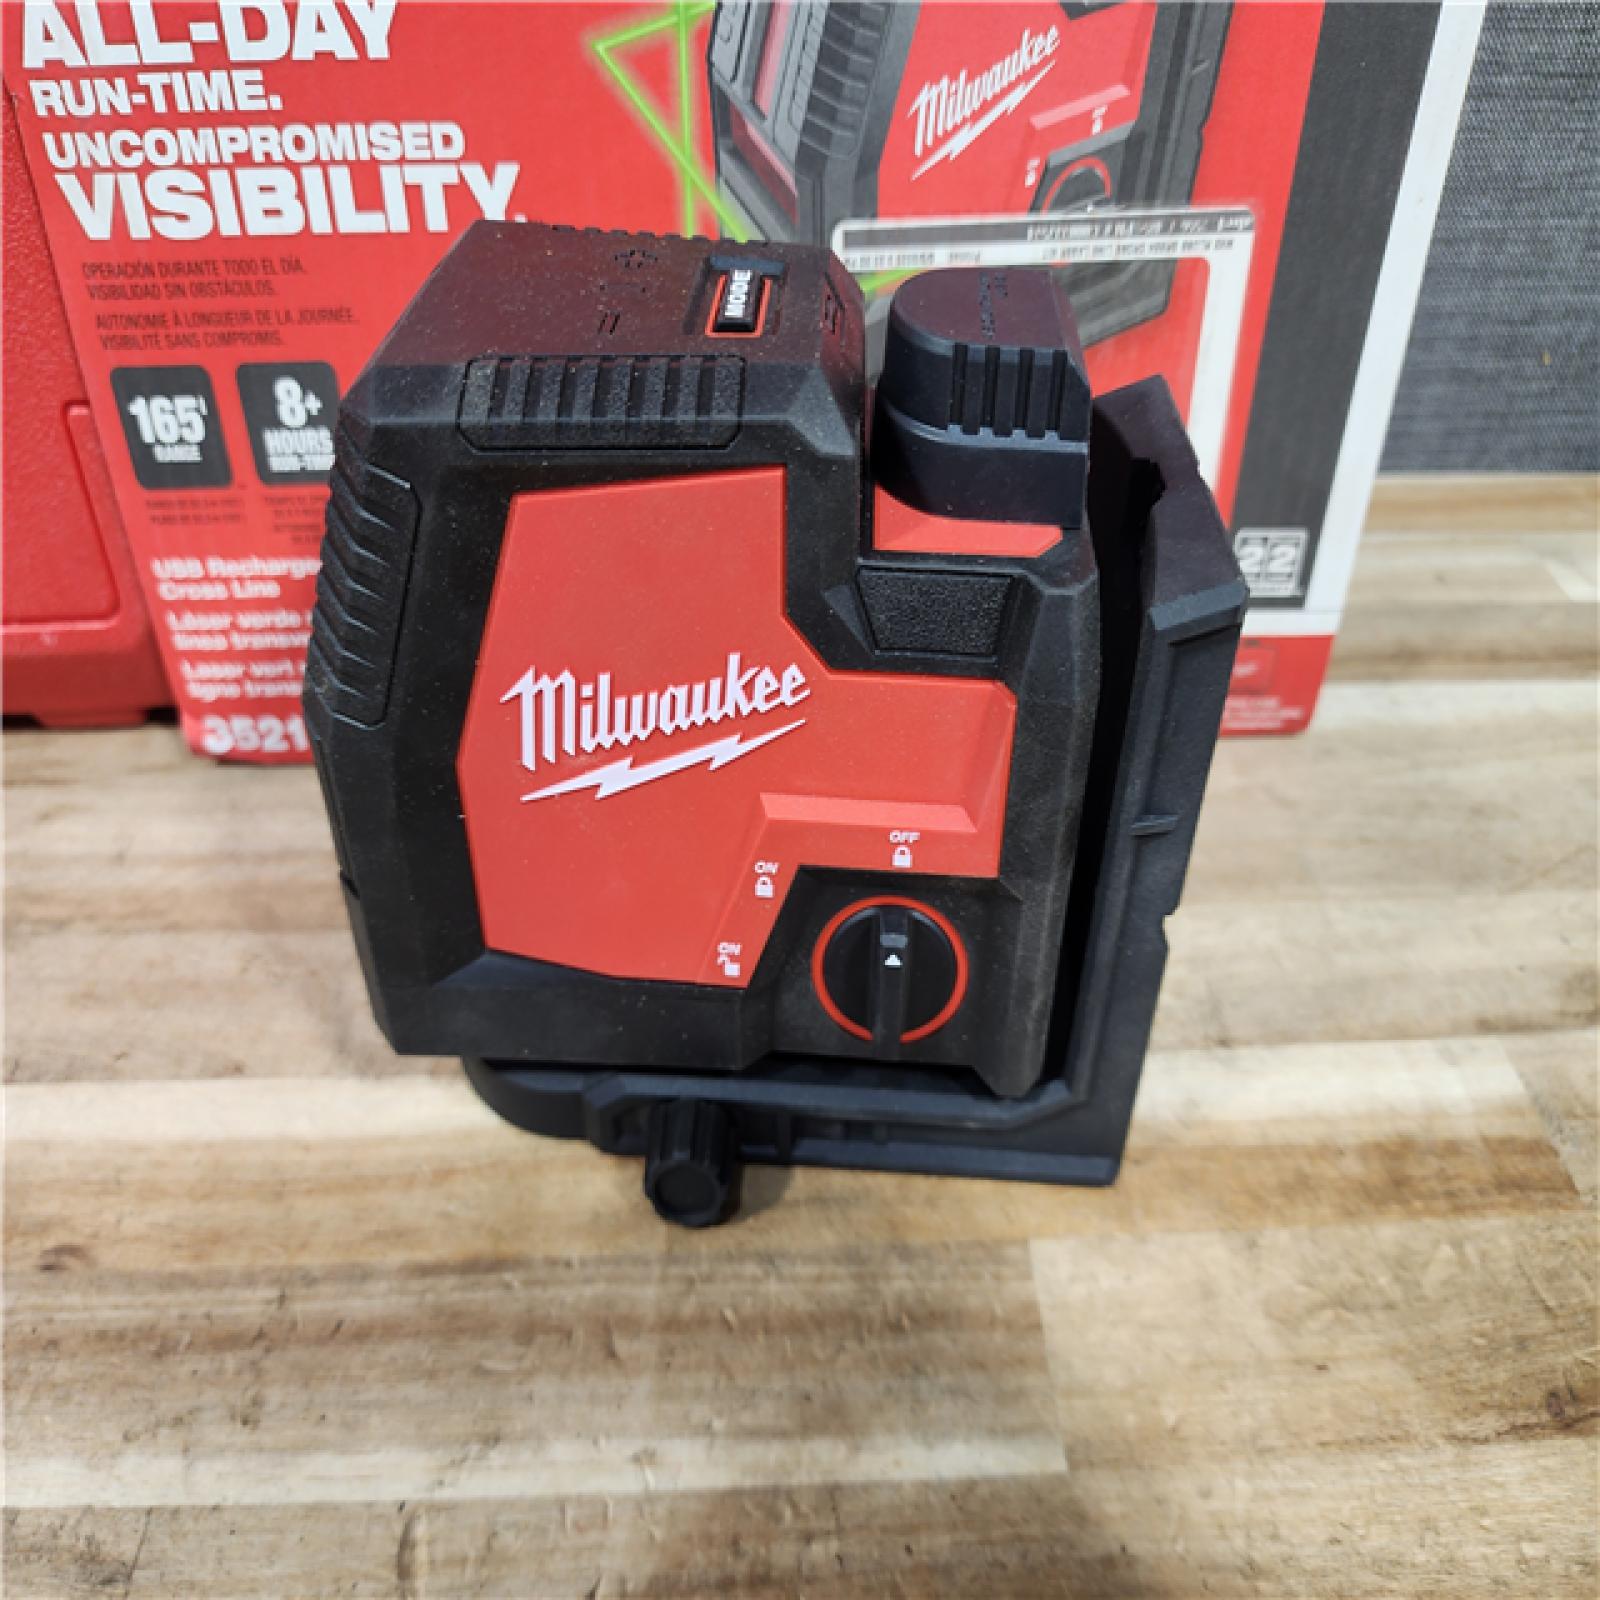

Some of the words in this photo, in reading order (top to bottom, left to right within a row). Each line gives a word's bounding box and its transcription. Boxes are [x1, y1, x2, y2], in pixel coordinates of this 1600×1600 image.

[21, 0, 399, 68] ALL-DAY
[29, 69, 283, 118] RUN-TIME.
[907, 25, 1061, 157] Milwaukee
[42, 121, 466, 168] UNCOMPROMISED
[54, 162, 527, 241] VISIBILITY.
[157, 259, 220, 278] DURANTE
[222, 258, 260, 276] TODO
[261, 258, 279, 275] EL
[164, 282, 186, 298] SIN
[725, 269, 752, 318] MODE
[255, 310, 273, 325] DE
[274, 309, 294, 325] LA
[273, 375, 323, 428] 8+
[158, 581, 228, 600] Cross
[231, 579, 281, 599] Line
[203, 713, 311, 755] 3521
[499, 652, 811, 772] Milwaukee
[888, 830, 921, 844] OFF
[754, 859, 780, 874] ON
[717, 942, 743, 956] ON
